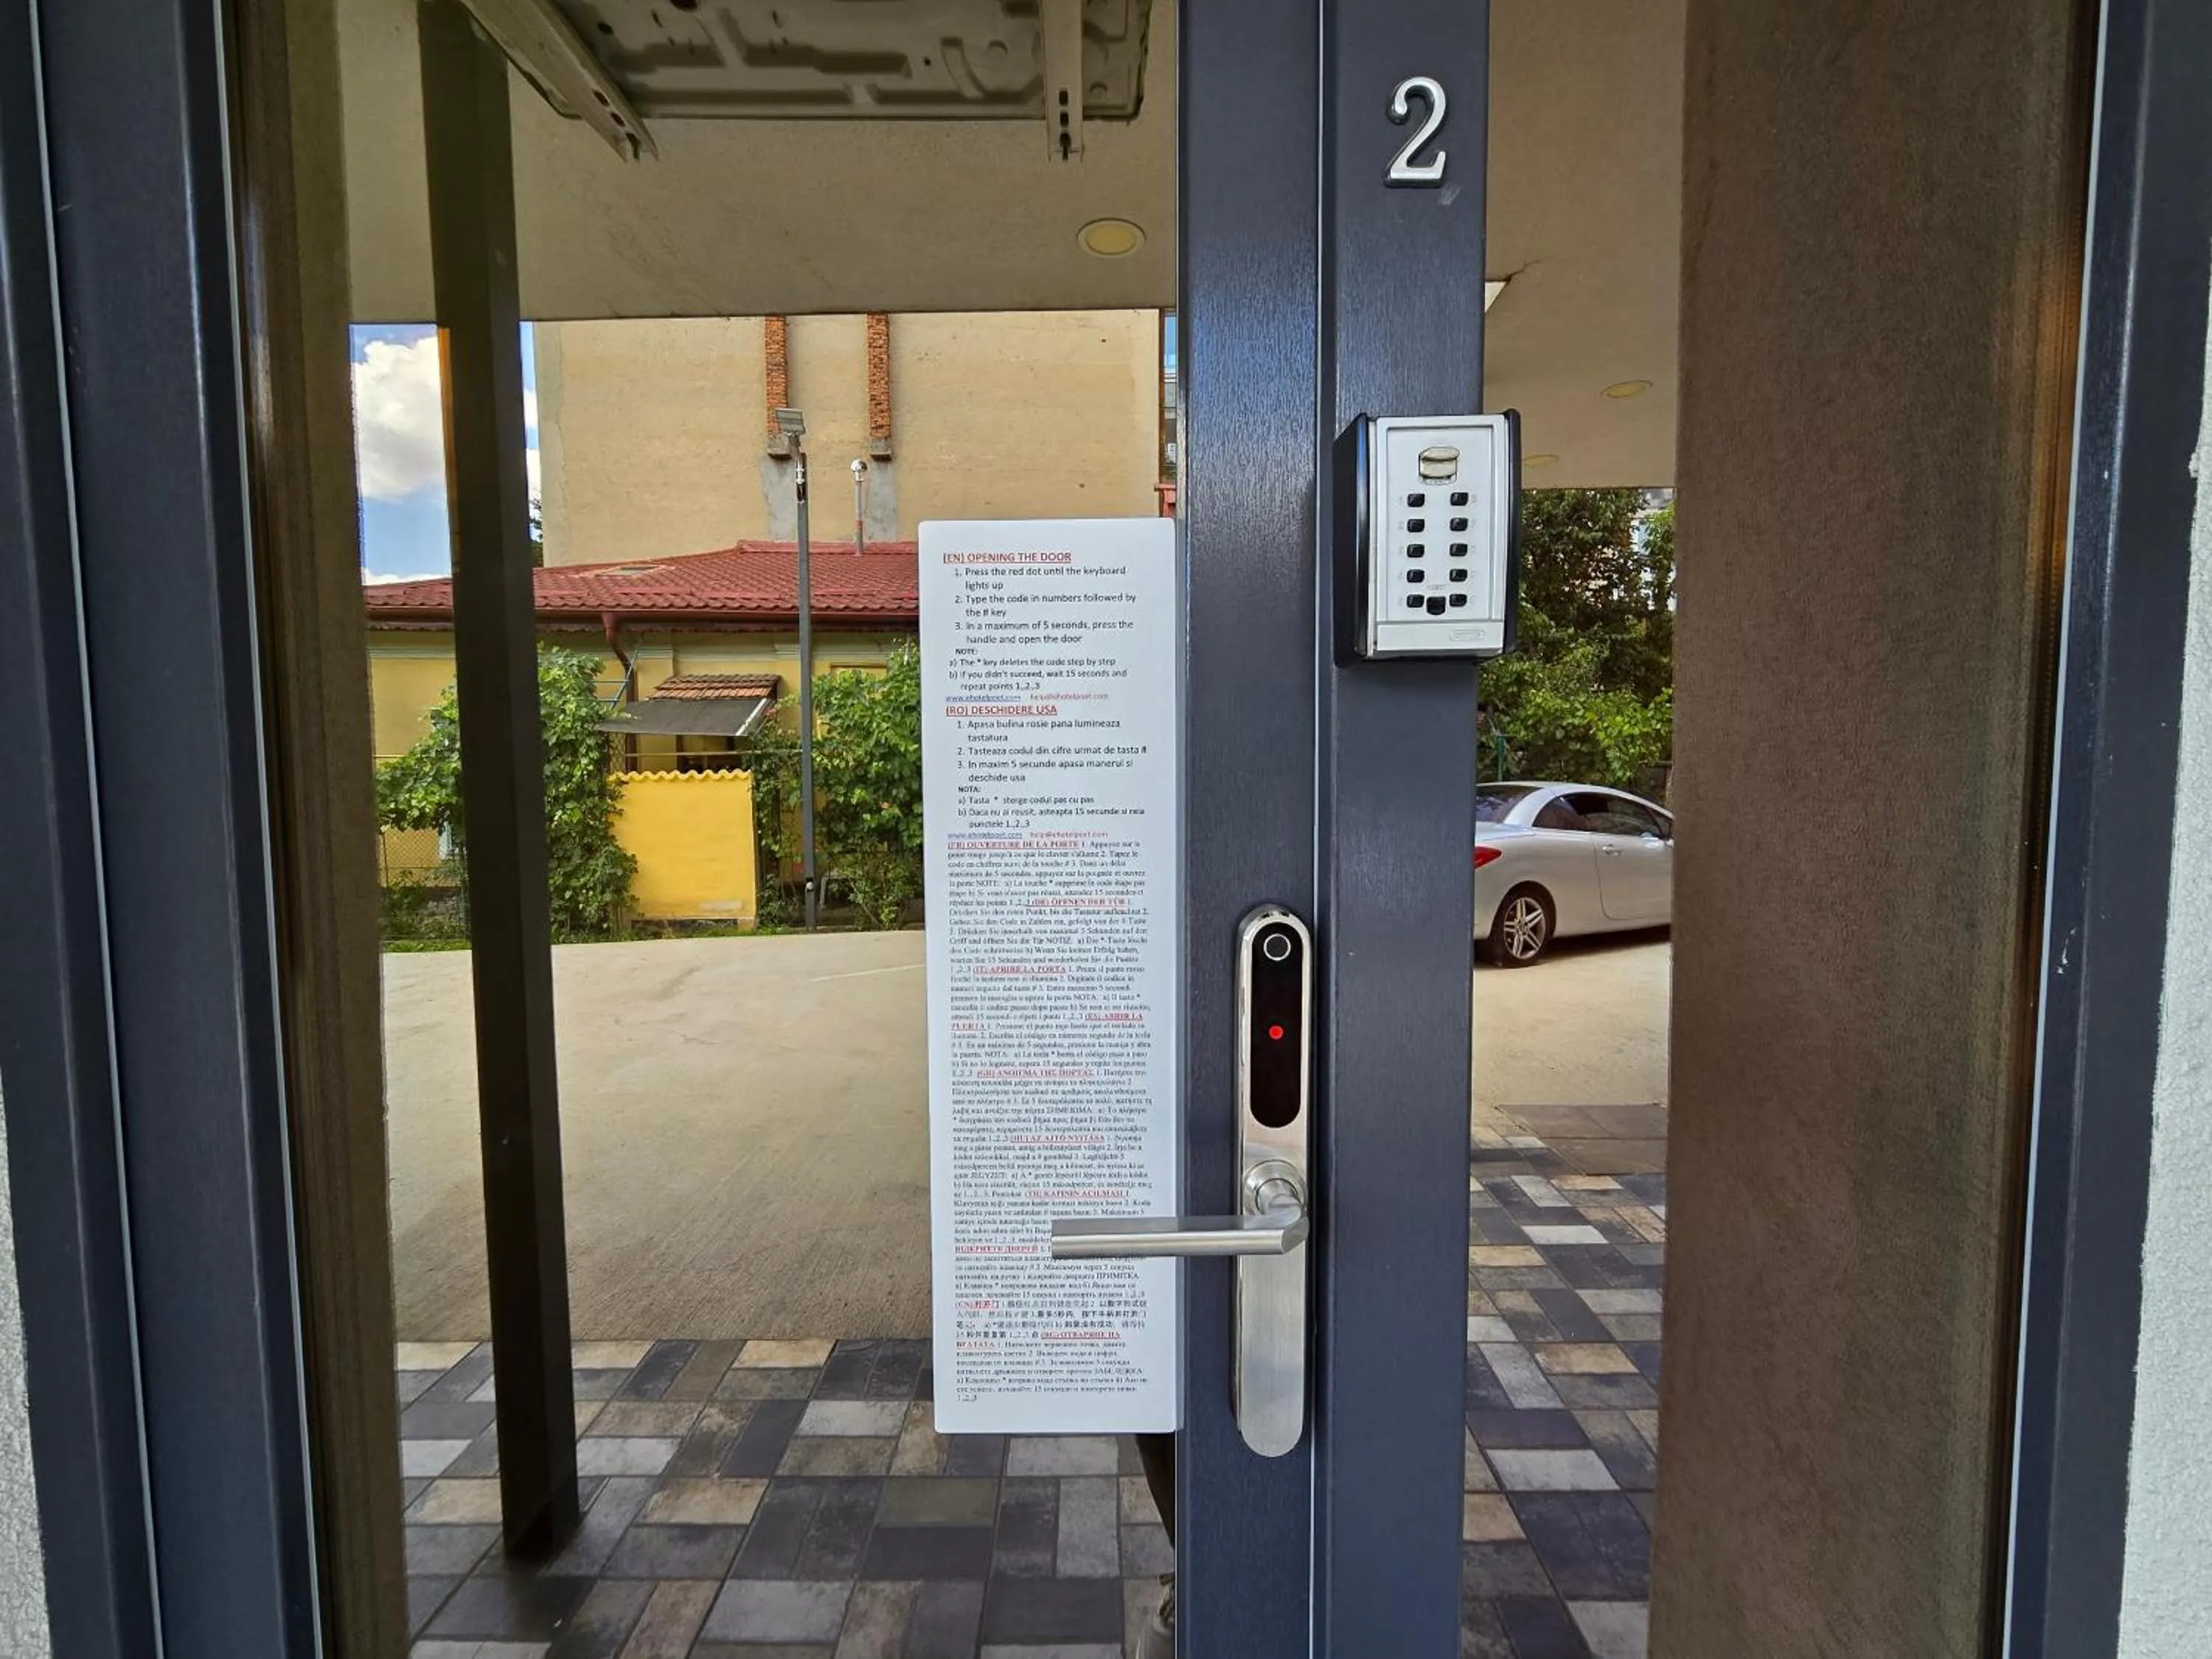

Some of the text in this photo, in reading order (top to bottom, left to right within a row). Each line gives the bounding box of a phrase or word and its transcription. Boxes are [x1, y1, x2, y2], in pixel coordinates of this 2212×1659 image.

[1384, 76, 1447, 187] 2
[967, 552, 1015, 563] OPENING
[1018, 552, 1037, 563] THE
[1040, 552, 1071, 563] DOOR
[965, 567, 989, 576] Press
[990, 567, 1006, 576] the
[1008, 567, 1024, 576] red
[1026, 566, 1041, 576] dot
[1043, 566, 1064, 576] until
[1066, 566, 1082, 575] the
[1083, 566, 1127, 577] keyboard
[964, 580, 1004, 591] lights up
[965, 594, 987, 605] Type
[989, 594, 1005, 603] the
[1006, 594, 1029, 603] code
[1031, 594, 1040, 602] in
[1042, 593, 1082, 603] numbers
[1083, 592, 1124, 603] followed
[1125, 594, 1136, 604] by
[965, 608, 981, 617] the
[990, 608, 1006, 619] key
[965, 622, 974, 630] In
[984, 622, 1029, 630] maximum
[1032, 620, 1041, 630] of
[1043, 621, 1049, 630] 5
[1051, 620, 1091, 630] seconds,
[1092, 621, 1117, 630] press
[1119, 620, 1133, 629] the
[967, 633, 1082, 645] handle and open the door
[983, 658, 998, 667] key
[999, 658, 1029, 666] deletes
[1030, 658, 1045, 666] the
[1046, 658, 1065, 666] code
[1067, 658, 1085, 667] step
[1086, 658, 1096, 667] by
[1098, 658, 1116, 667] step
[984, 669, 1008, 678] didn't
[1047, 669, 1063, 678] wait
[1065, 669, 1076, 678] 15
[1077, 669, 1110, 678] seconds
[1111, 669, 1127, 677] and
[960, 683, 987, 692] repeat
[988, 682, 1014, 691] points
[971, 704, 1033, 716] DESCHIDERE
[1036, 704, 1057, 716] USA
[967, 720, 995, 730] Apasa
[996, 719, 1024, 728] bulina
[1026, 720, 1048, 728] rosie
[1051, 720, 1073, 729] pana
[1074, 719, 1120, 728] lumineaza
[967, 734, 1009, 742] tastatura
[968, 746, 1006, 756] Tasteaza
[1008, 745, 1033, 755] codul
[1035, 745, 1049, 754] din
[1051, 745, 1072, 754] cifre
[1074, 746, 1102, 754] urmat
[1104, 745, 1116, 754] de
[968, 760, 977, 768] In
[978, 760, 1009, 768] maxim
[1011, 759, 1017, 768] 5
[1019, 759, 1057, 768] secunde
[1058, 760, 1084, 770] apasa
[1086, 759, 1124, 768] manerul
[1125, 759, 1133, 768] si
[968, 773, 1026, 782] deschide usa
[958, 785, 981, 793] NOTA:
[969, 796, 990, 804] Tasta
[1029, 796, 1052, 804] codul
[1053, 796, 1067, 804] pas
[1080, 796, 1095, 804] pas
[969, 808, 989, 816] Daca
